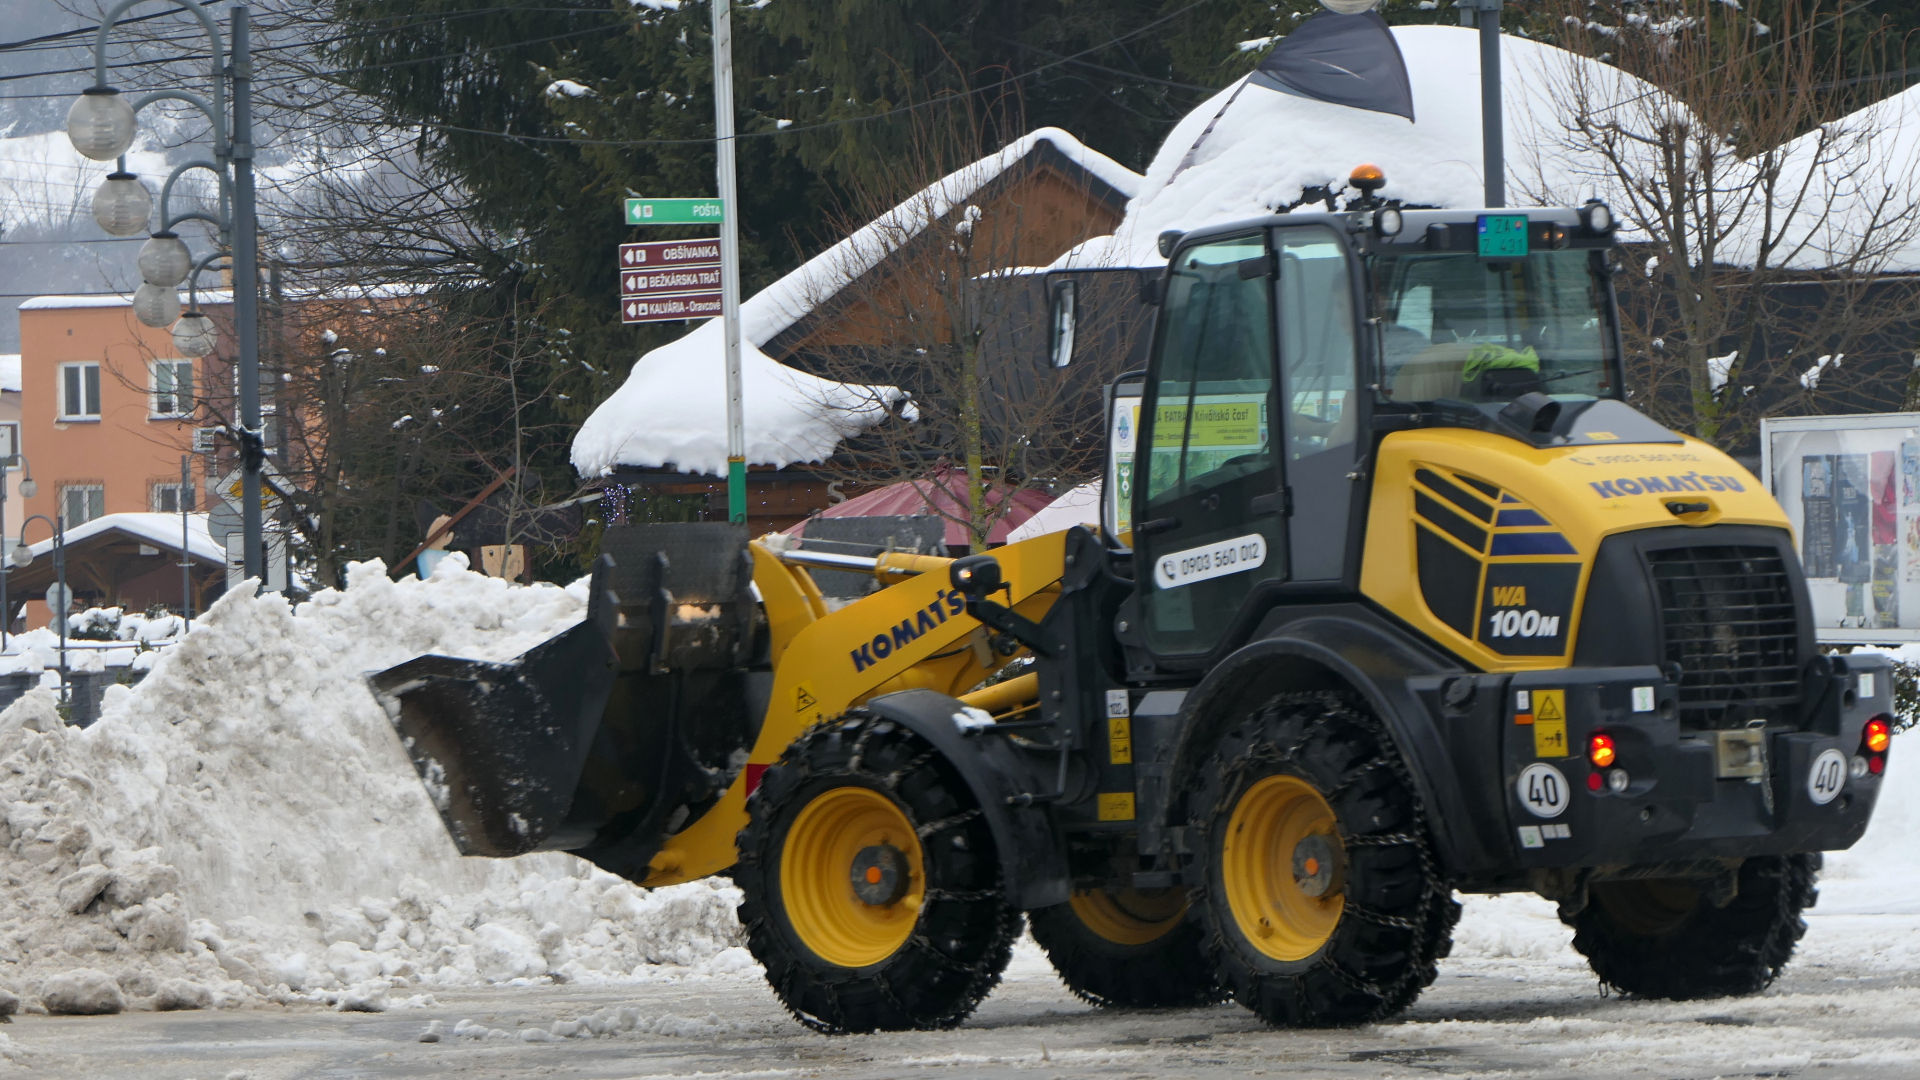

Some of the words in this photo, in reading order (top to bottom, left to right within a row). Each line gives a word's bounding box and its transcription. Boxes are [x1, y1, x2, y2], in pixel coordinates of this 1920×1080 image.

[693, 203, 721, 217] POŠTA
[1495, 218, 1511, 233] ZA
[663, 245, 719, 261] OBŠÍVANKA
[1500, 238, 1523, 253] 431
[649, 273, 698, 288] BEŽKÁRSKA
[699, 271, 720, 284] TRAŤ
[649, 300, 685, 314] KALVÁRIA
[689, 299, 721, 312] Oravcové
[1589, 471, 1746, 499] KOMATSU
[1181, 553, 1211, 576] 0903
[1214, 548, 1237, 568] 560
[1240, 542, 1260, 562] 012
[1492, 586, 1527, 607] WA
[850, 588, 975, 673] KOMATS
[1814, 759, 1840, 793] 40
[1529, 774, 1558, 807] 40
